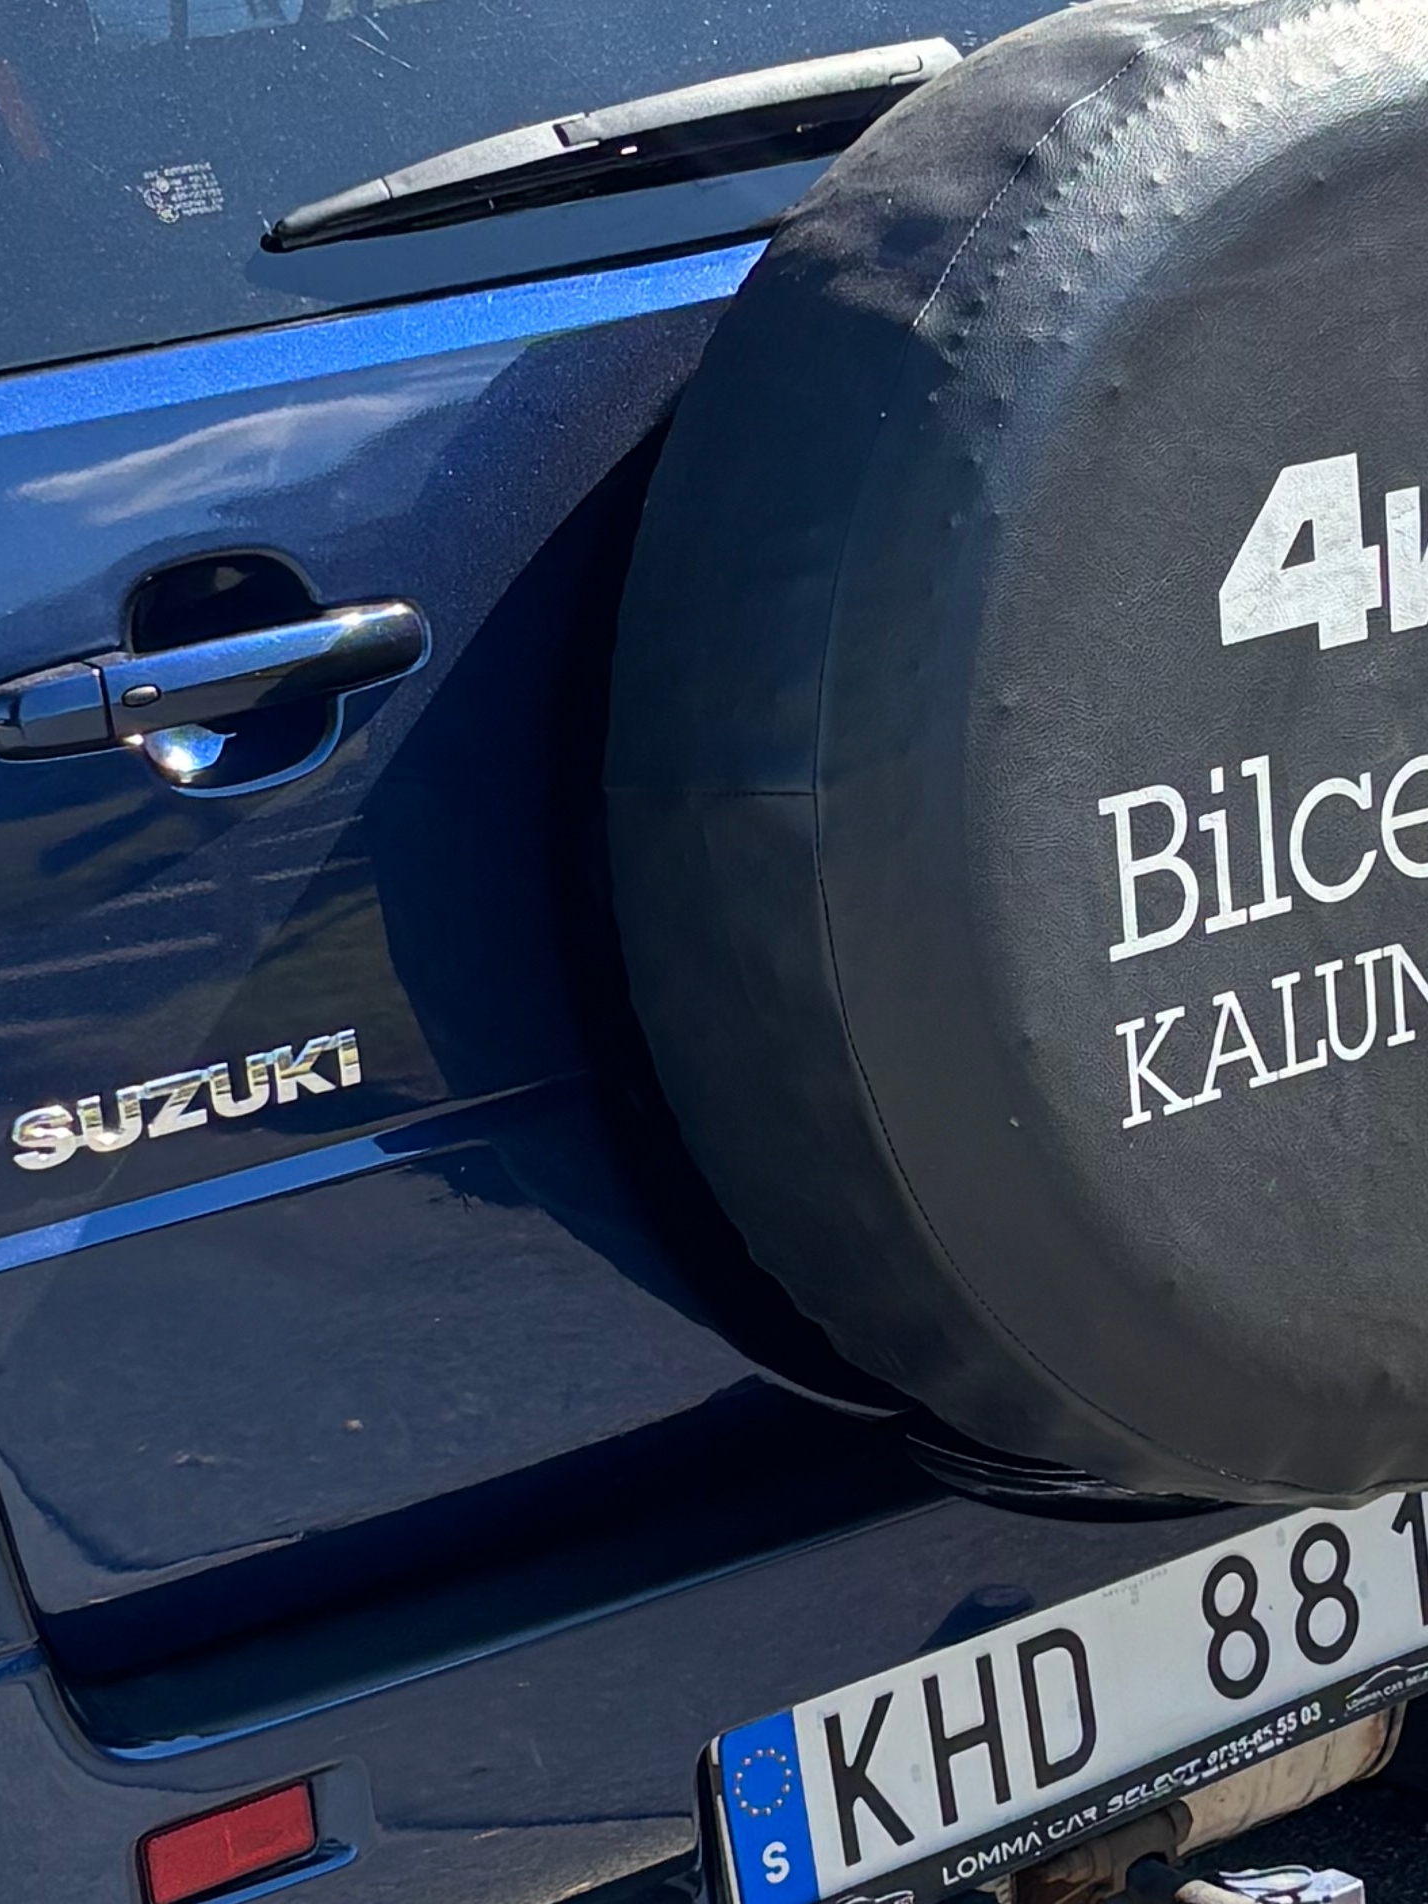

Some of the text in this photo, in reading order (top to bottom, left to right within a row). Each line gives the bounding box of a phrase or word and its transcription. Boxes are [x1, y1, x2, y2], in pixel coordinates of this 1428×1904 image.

[12, 1028, 363, 1170] SUZUKI
[824, 1627, 1097, 1866] KHD
[942, 1831, 1042, 1886] LOMMA
[1047, 1805, 1097, 1840] CAR
[1276, 1711, 1298, 1736] 55
[1299, 1701, 1321, 1725] 03
[761, 1840, 791, 1885] S
